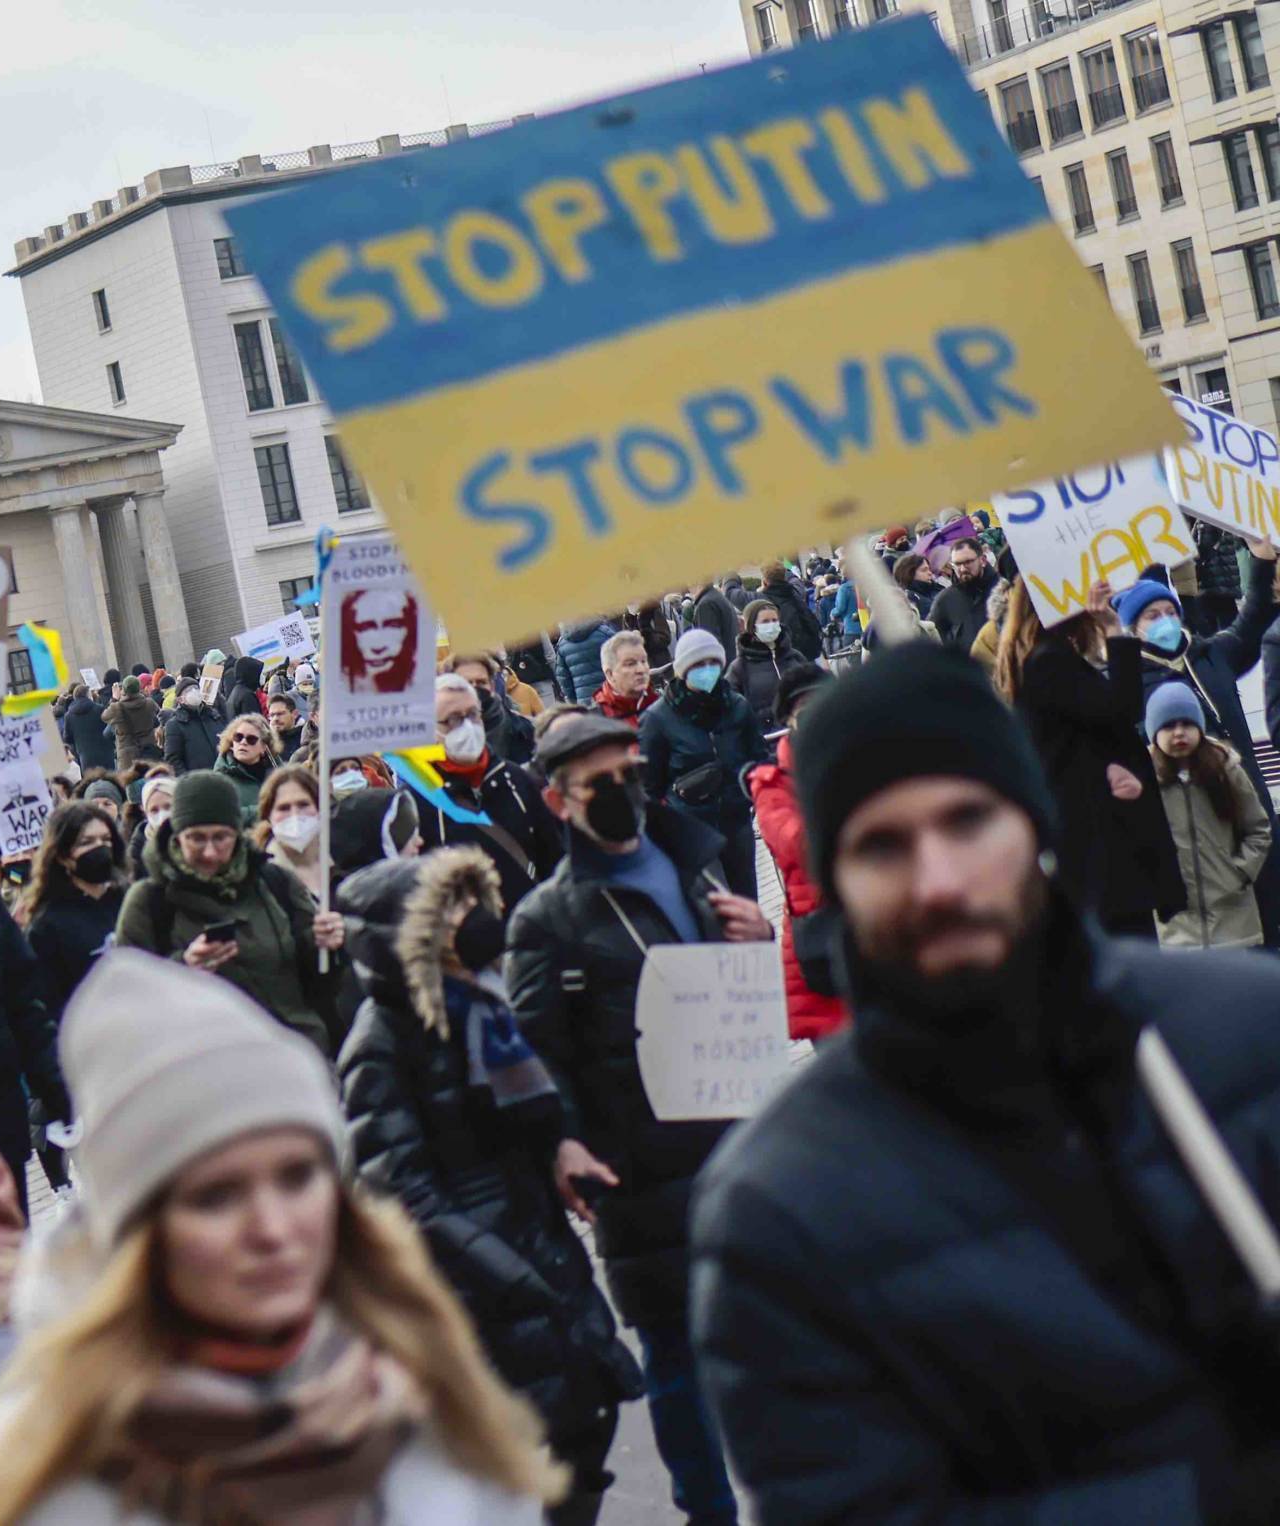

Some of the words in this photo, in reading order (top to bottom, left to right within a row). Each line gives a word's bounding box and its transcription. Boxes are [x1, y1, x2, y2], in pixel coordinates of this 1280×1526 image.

[291, 178, 609, 354] STOP
[606, 87, 972, 262] PUTIN
[459, 390, 762, 570] STOP
[769, 327, 1036, 463] WAR
[1170, 394, 1280, 476] STOP
[1028, 505, 1191, 616] WAR
[22, 719, 42, 737] ARE
[5, 826, 45, 852] CRIM
